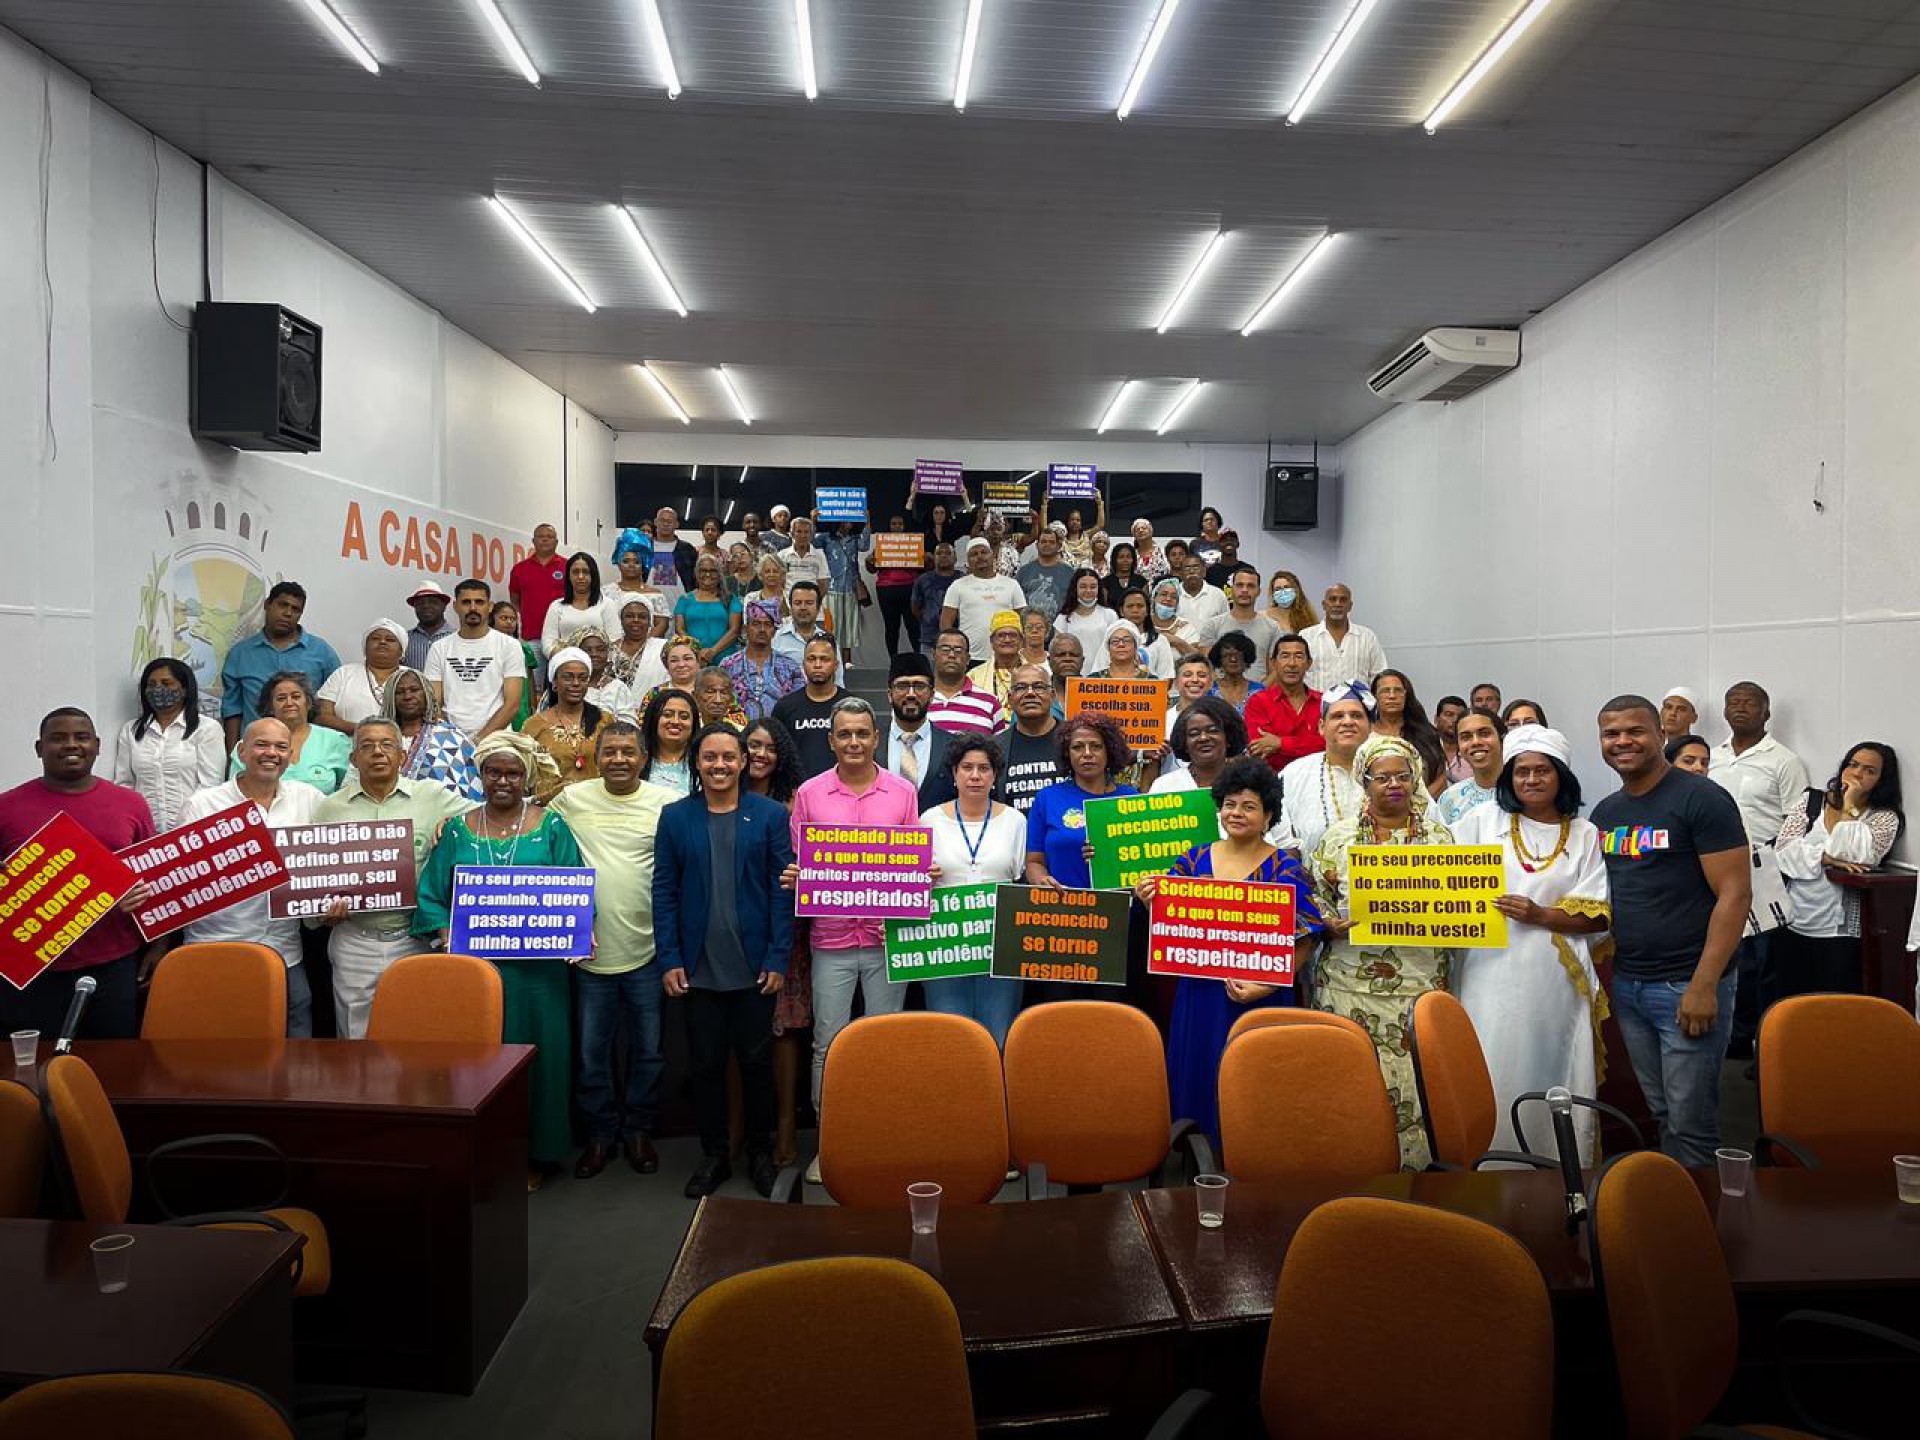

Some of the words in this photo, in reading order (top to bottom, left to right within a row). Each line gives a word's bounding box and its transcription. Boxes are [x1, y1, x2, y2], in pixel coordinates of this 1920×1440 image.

[341, 501, 368, 561] A
[379, 509, 462, 577] CASA
[472, 531, 505, 583] DO
[1078, 682, 1120, 694] Aceitar
[1122, 682, 1129, 694] é
[1132, 685, 1157, 695] uma
[1081, 700, 1128, 711] escolha
[1129, 701, 1152, 712] sua.
[795, 718, 832, 730] LACOS
[1132, 717, 1139, 727] é
[1141, 719, 1159, 728] um
[1008, 761, 1057, 777] CONTRA
[1117, 798, 1146, 814] Que
[1149, 794, 1183, 811] todo
[179, 829, 204, 853] fé
[204, 816, 246, 844] não
[245, 806, 262, 826] é
[275, 829, 289, 847] A
[292, 823, 371, 846] religião
[375, 824, 406, 839] não
[1106, 814, 1199, 838] preconceito
[806, 827, 887, 844] Sociedade
[890, 829, 928, 846] justa
[212, 839, 262, 871] para
[284, 853, 340, 869] define
[342, 851, 370, 864] um
[371, 848, 400, 862] ser
[813, 848, 822, 862] é
[834, 851, 859, 864] que
[862, 851, 886, 864] tem
[888, 853, 919, 865] seus
[1118, 845, 1140, 862] se
[1143, 840, 1192, 859] torne
[1350, 853, 1378, 866] Tire
[1382, 854, 1408, 866] seu
[1412, 852, 1501, 868] preconceito
[0, 848, 76, 923] econceito
[290, 872, 364, 890] humano,
[365, 869, 397, 884] seu
[457, 872, 484, 886] Tire
[485, 874, 511, 886] seu
[513, 873, 594, 887] preconceito
[800, 868, 850, 882] direitos
[851, 870, 932, 883] preservados
[1355, 876, 1373, 889] do
[1376, 875, 1444, 890] caminho,
[1446, 875, 1499, 891] quero
[35, 873, 91, 921] torne
[140, 900, 183, 927] sua
[181, 859, 283, 909] violência.
[800, 893, 810, 905] e
[812, 888, 929, 908] respeitados!
[1030, 888, 1059, 905] Que
[1062, 889, 1096, 907] todo
[1159, 878, 1244, 901] Sociedade
[365, 892, 402, 909] sim!
[458, 893, 476, 907] do
[478, 893, 540, 907] caminho,
[542, 893, 589, 908] quero
[942, 893, 961, 912] fé
[963, 890, 996, 910] não
[1369, 900, 1429, 914] passar
[1433, 900, 1471, 914] com
[1475, 900, 1486, 913] a
[468, 914, 525, 929] passar
[528, 914, 562, 928] com
[565, 914, 576, 928] a
[1015, 911, 1108, 930] preconceito
[1166, 903, 1176, 917] é
[1178, 906, 1186, 918] a
[1188, 907, 1215, 921] que
[1217, 908, 1243, 923] tem
[1246, 911, 1281, 926] seus
[12, 917, 43, 943] se
[897, 921, 959, 943] motivo
[962, 918, 993, 938] par
[1152, 922, 1204, 939] direitos
[1206, 927, 1295, 947] preservados
[1370, 920, 1426, 937] minha
[1430, 922, 1485, 938] veste!
[469, 934, 521, 950] minha
[524, 934, 574, 950] veste!
[1022, 935, 1045, 952] se
[1049, 935, 1099, 955] torne
[890, 951, 925, 968] sua
[927, 942, 993, 965] violênc
[1153, 949, 1162, 961] e
[1166, 946, 1291, 973] respeitados!
